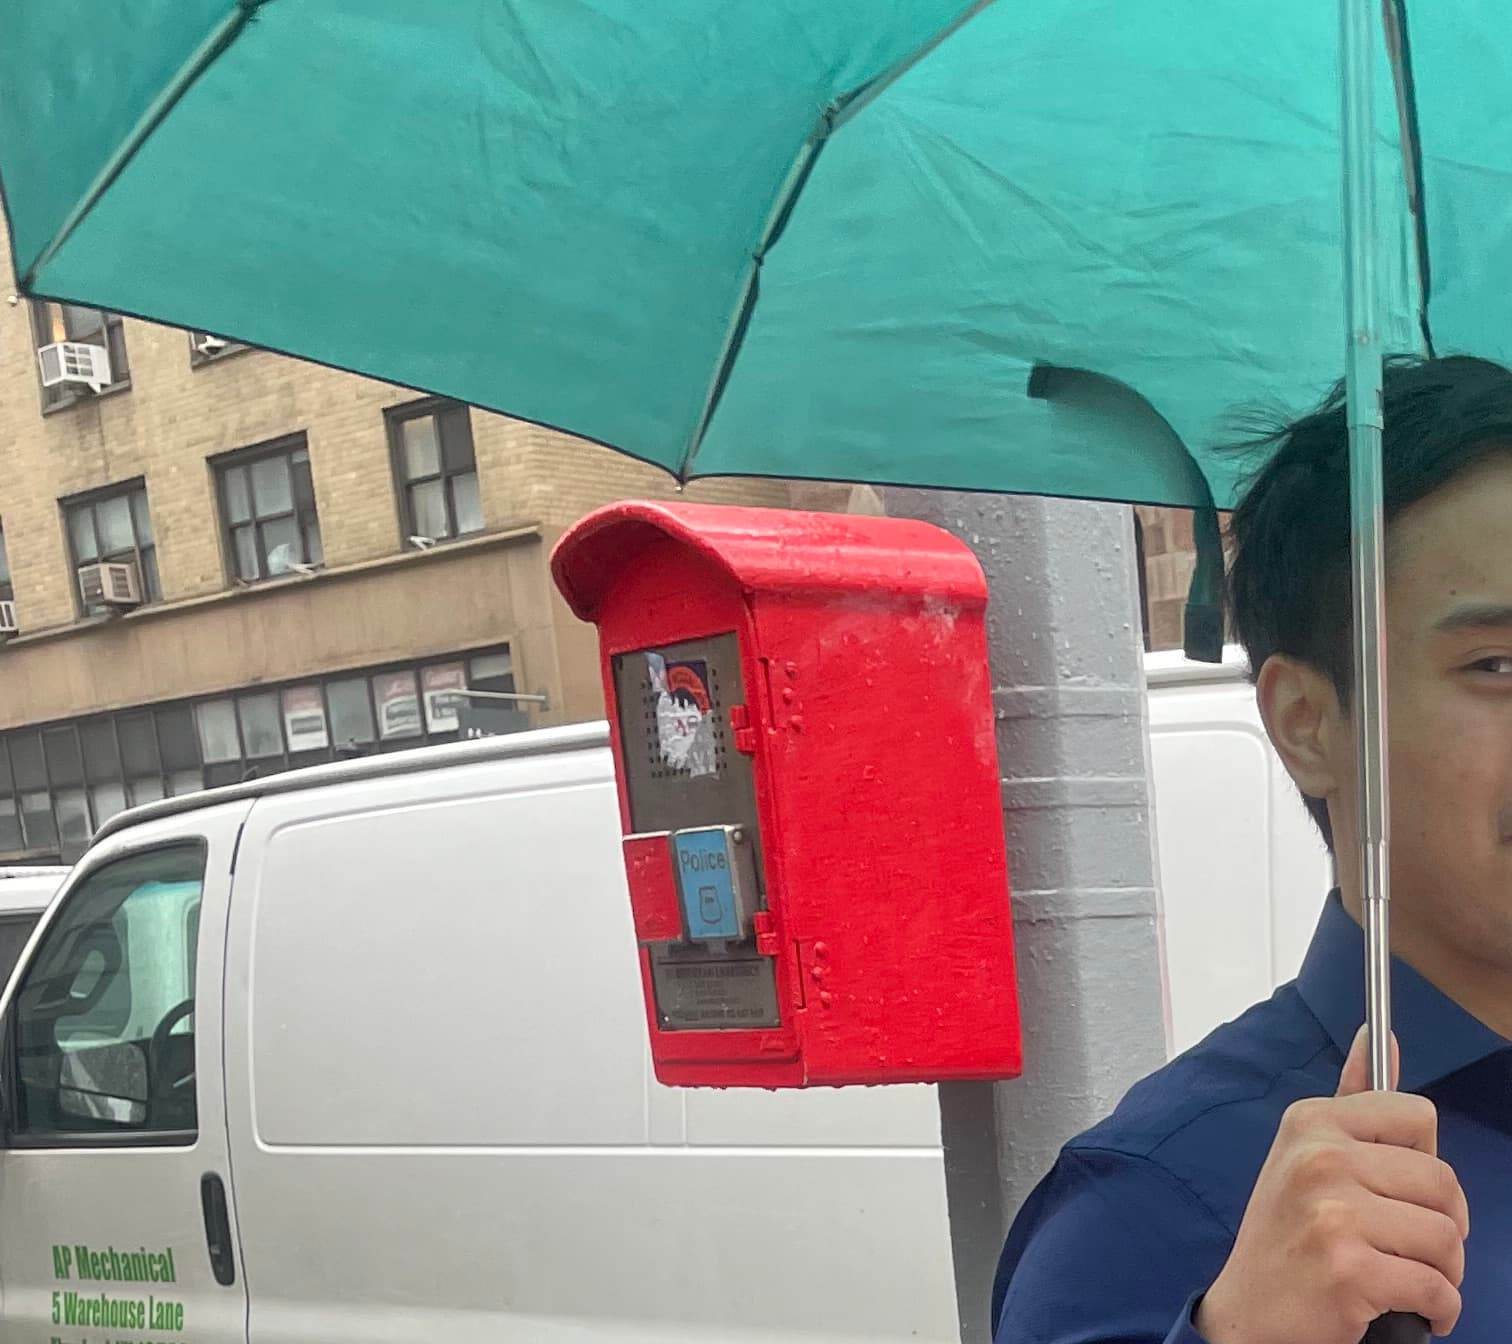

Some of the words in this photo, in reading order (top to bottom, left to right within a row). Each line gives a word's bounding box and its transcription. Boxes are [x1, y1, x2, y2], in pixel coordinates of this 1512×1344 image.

[680, 849, 726, 872] Police
[52, 1245, 72, 1279] AP
[74, 1245, 176, 1283] Mechanical
[52, 1291, 61, 1325] 5
[63, 1291, 145, 1329] Warehouse
[149, 1295, 184, 1331] Lane
